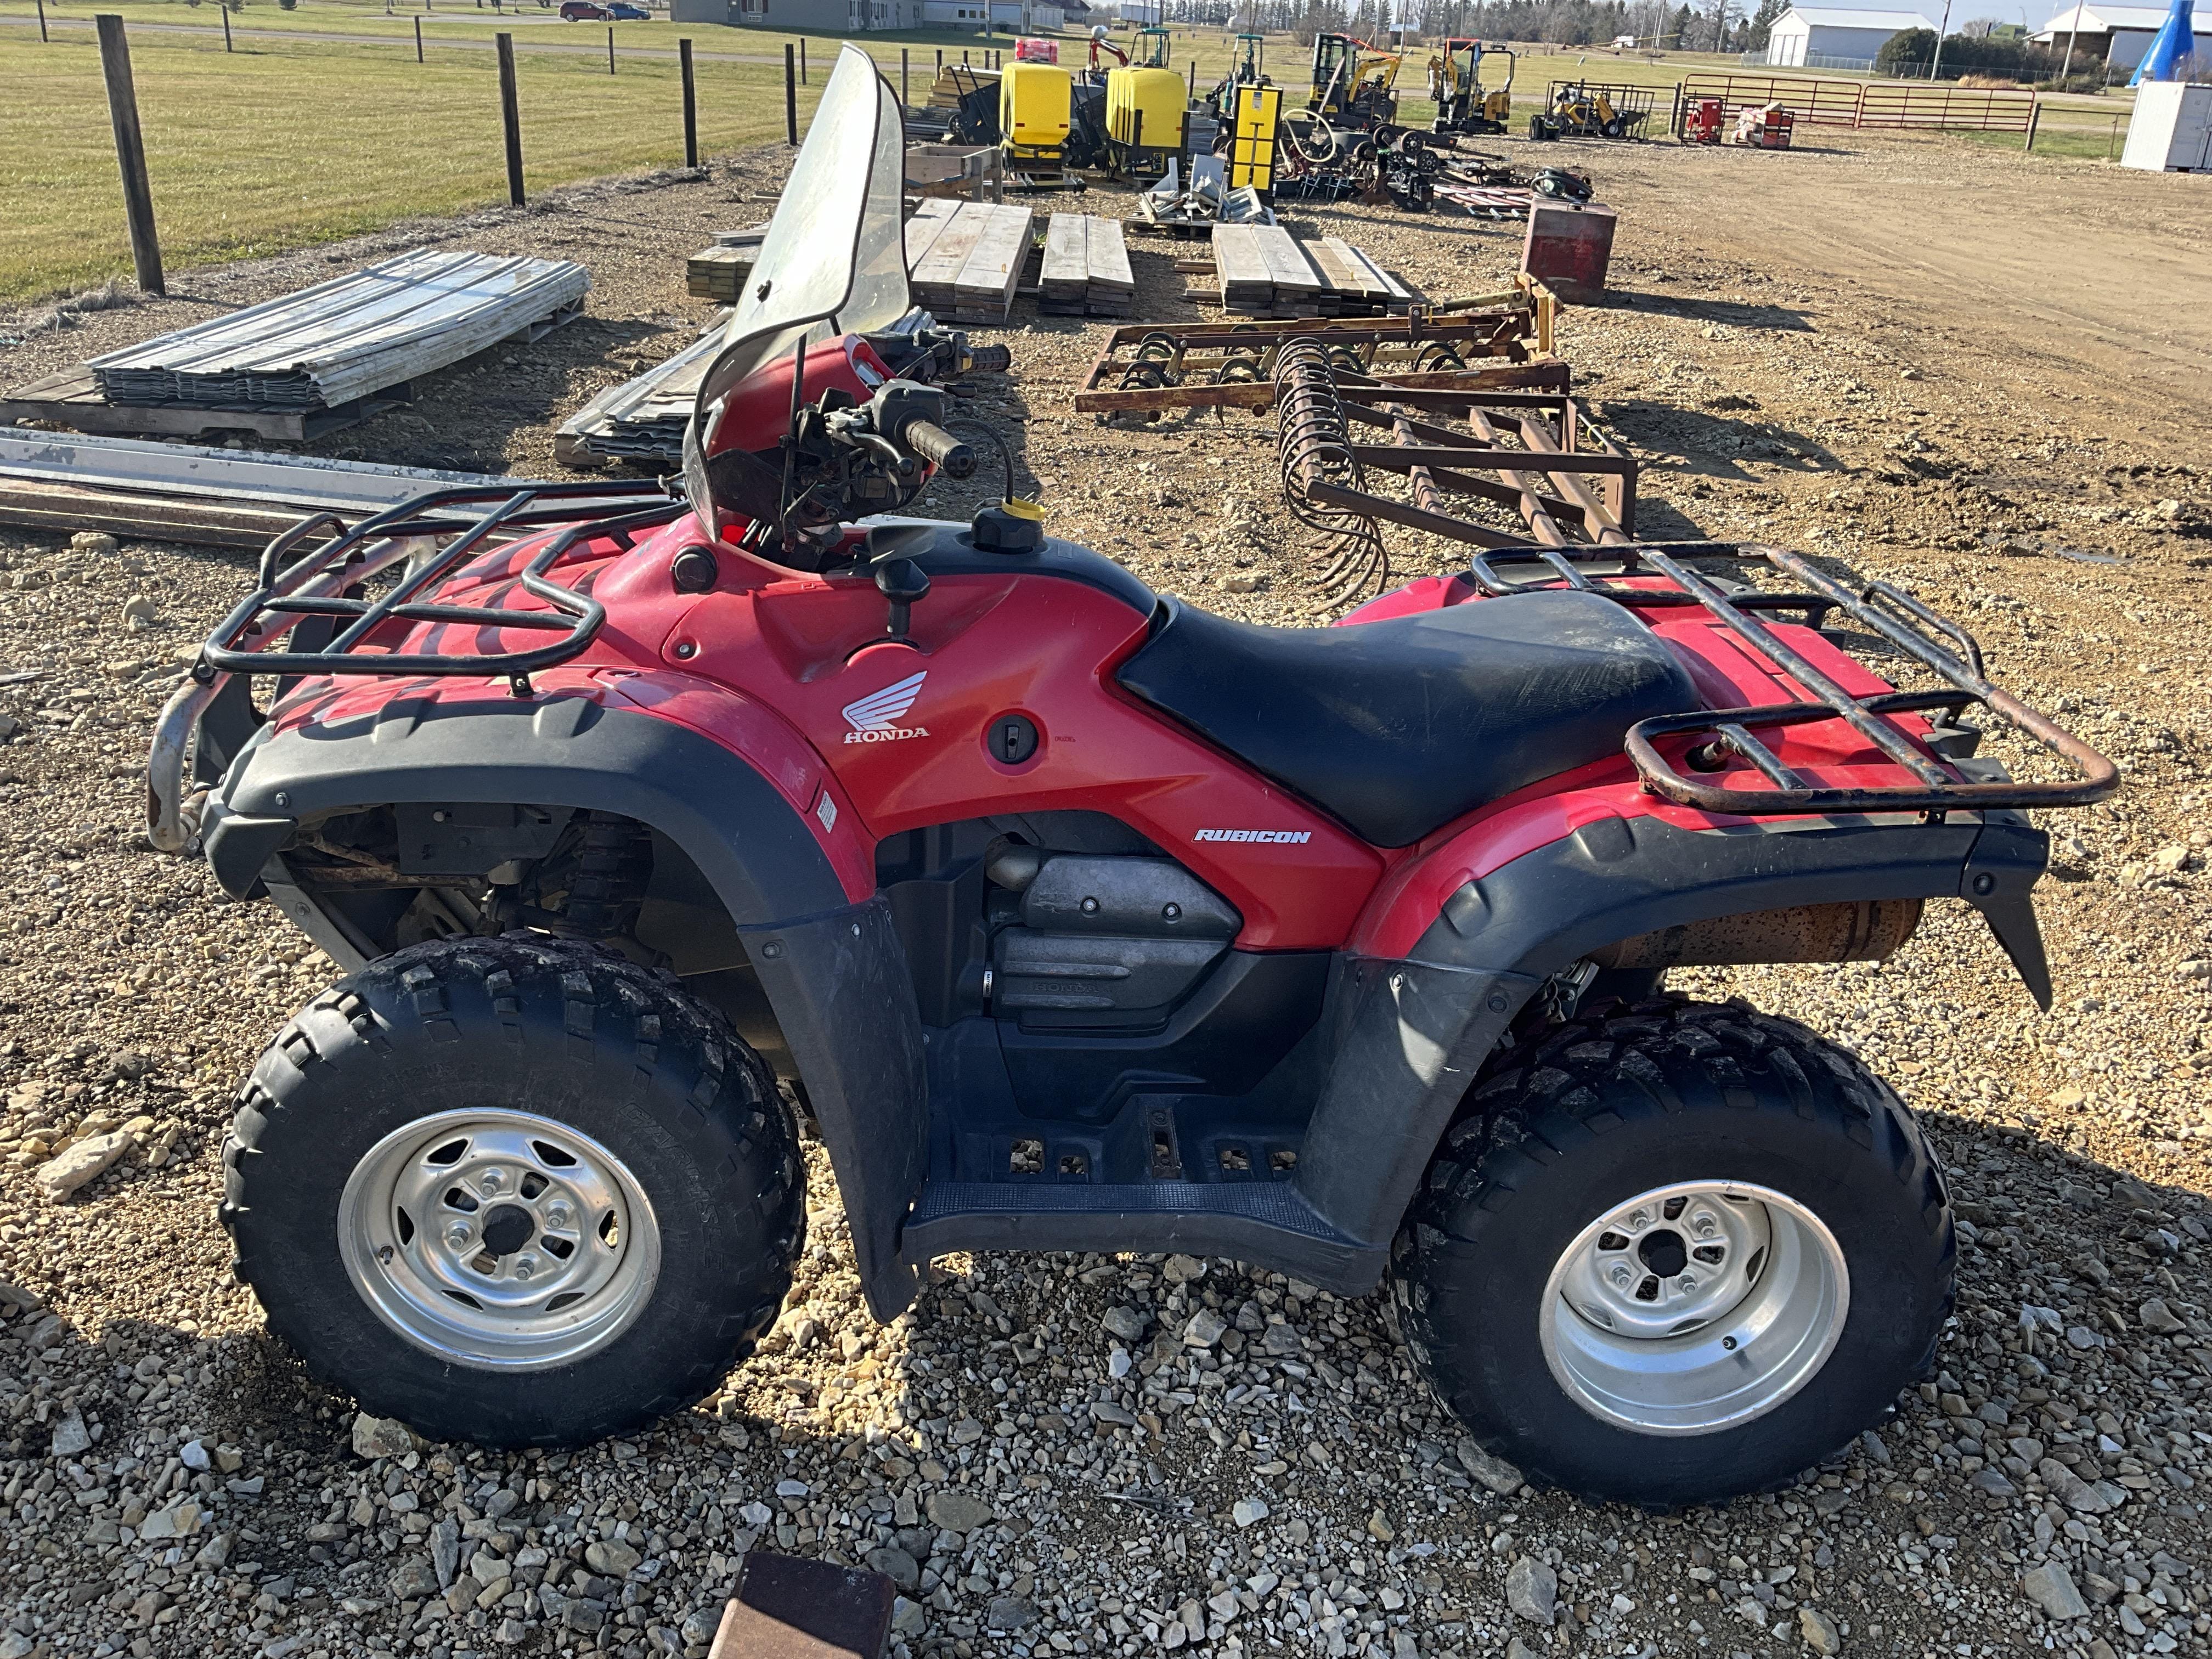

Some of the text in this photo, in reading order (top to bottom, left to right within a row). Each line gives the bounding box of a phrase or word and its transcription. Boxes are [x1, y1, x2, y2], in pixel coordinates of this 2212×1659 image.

[844, 727, 930, 743] HONDA
[1193, 828, 1312, 844] RUBICON
[1033, 983, 1101, 994] HONDA
[618, 1103, 725, 1272] CARLISLE
